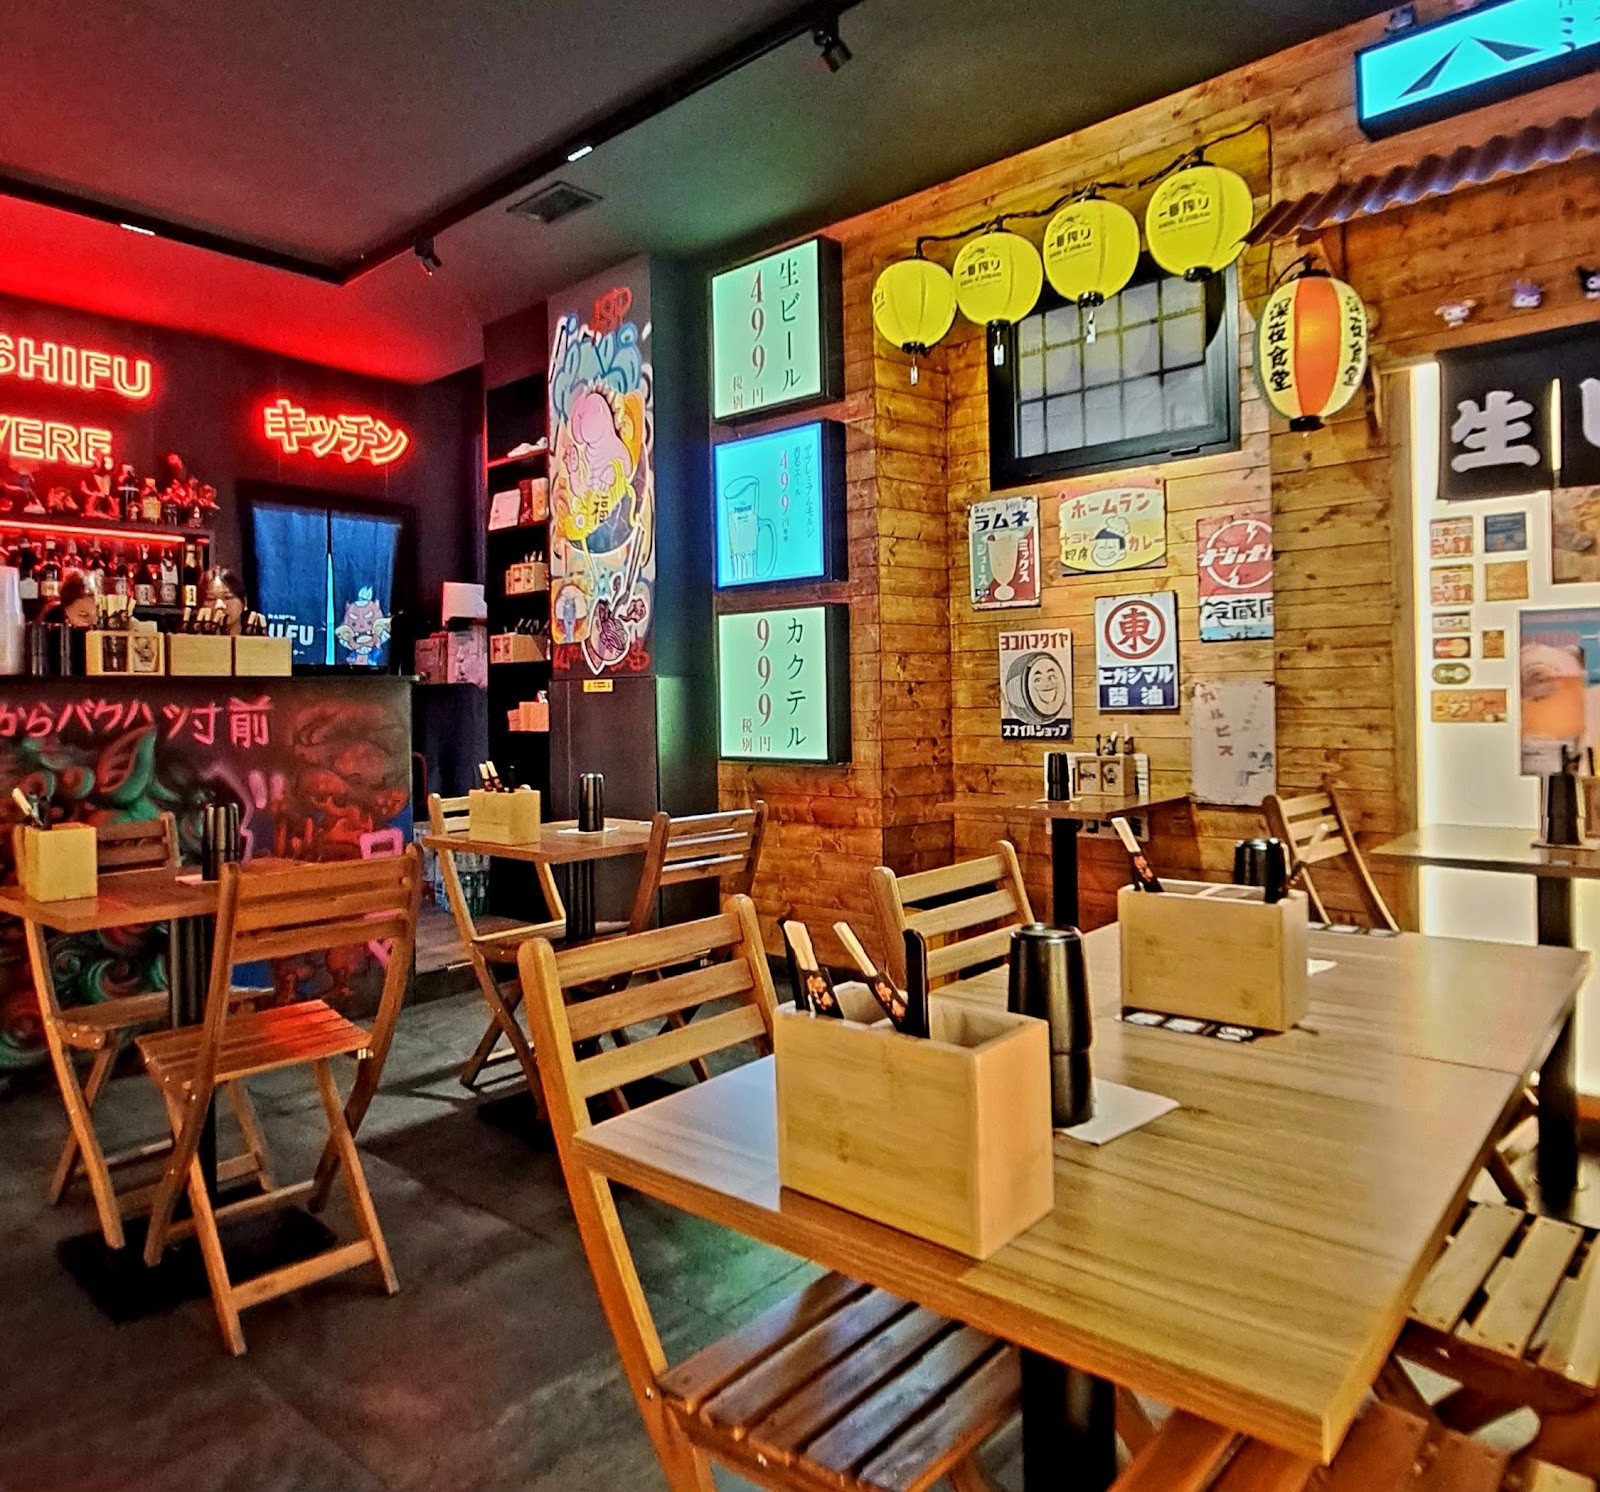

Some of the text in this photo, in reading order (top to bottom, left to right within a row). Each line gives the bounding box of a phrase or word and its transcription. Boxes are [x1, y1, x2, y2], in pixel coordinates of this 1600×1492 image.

[779, 257, 802, 393] 生ビール
[263, 399, 410, 467] キッチン
[1070, 492, 1151, 519] ホームラン
[974, 510, 1030, 532] ラムネ
[1128, 535, 1165, 552] カレー
[1001, 633, 1069, 651] ヨコハマタイヤ
[1117, 607, 1157, 653] 東
[786, 617, 807, 749] カクテル
[1099, 665, 1175, 686] ヒガシマル
[1003, 724, 1070, 737] スマイルショップ
